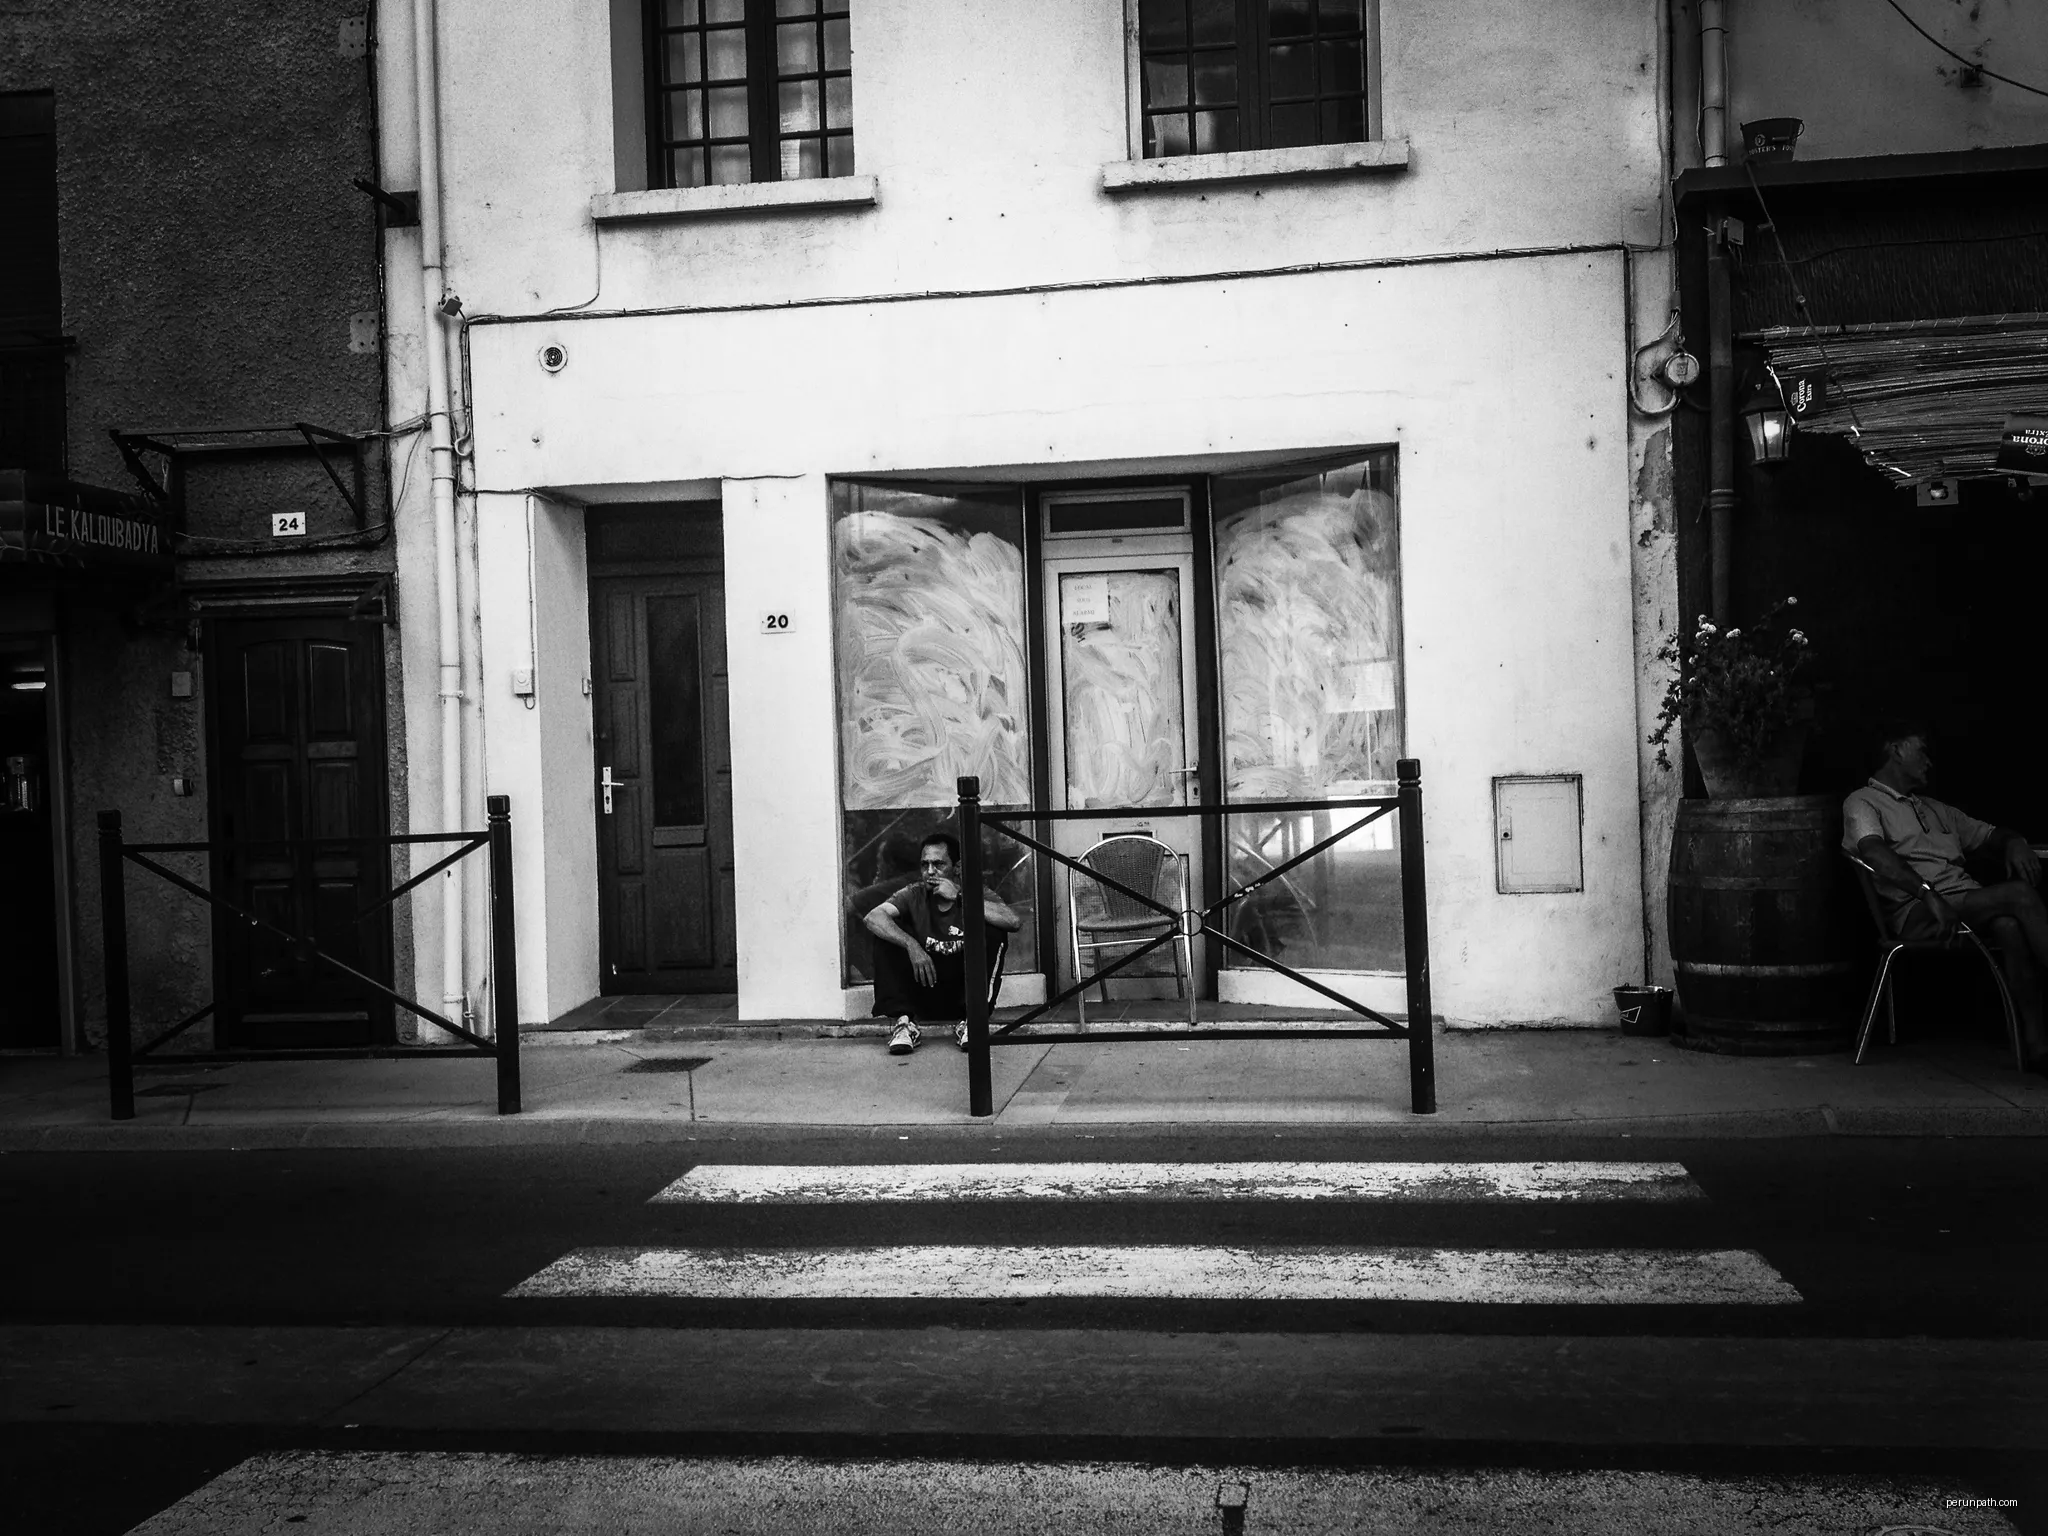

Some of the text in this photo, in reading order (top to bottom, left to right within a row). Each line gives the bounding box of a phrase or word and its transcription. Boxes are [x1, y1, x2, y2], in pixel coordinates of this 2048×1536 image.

[1796, 378, 1807, 412] Corona
[2011, 434, 2048, 446] orona
[45, 503, 159, 555] LE KALOUBADYA
[279, 517, 299, 531] 24
[767, 614, 789, 629] 20
